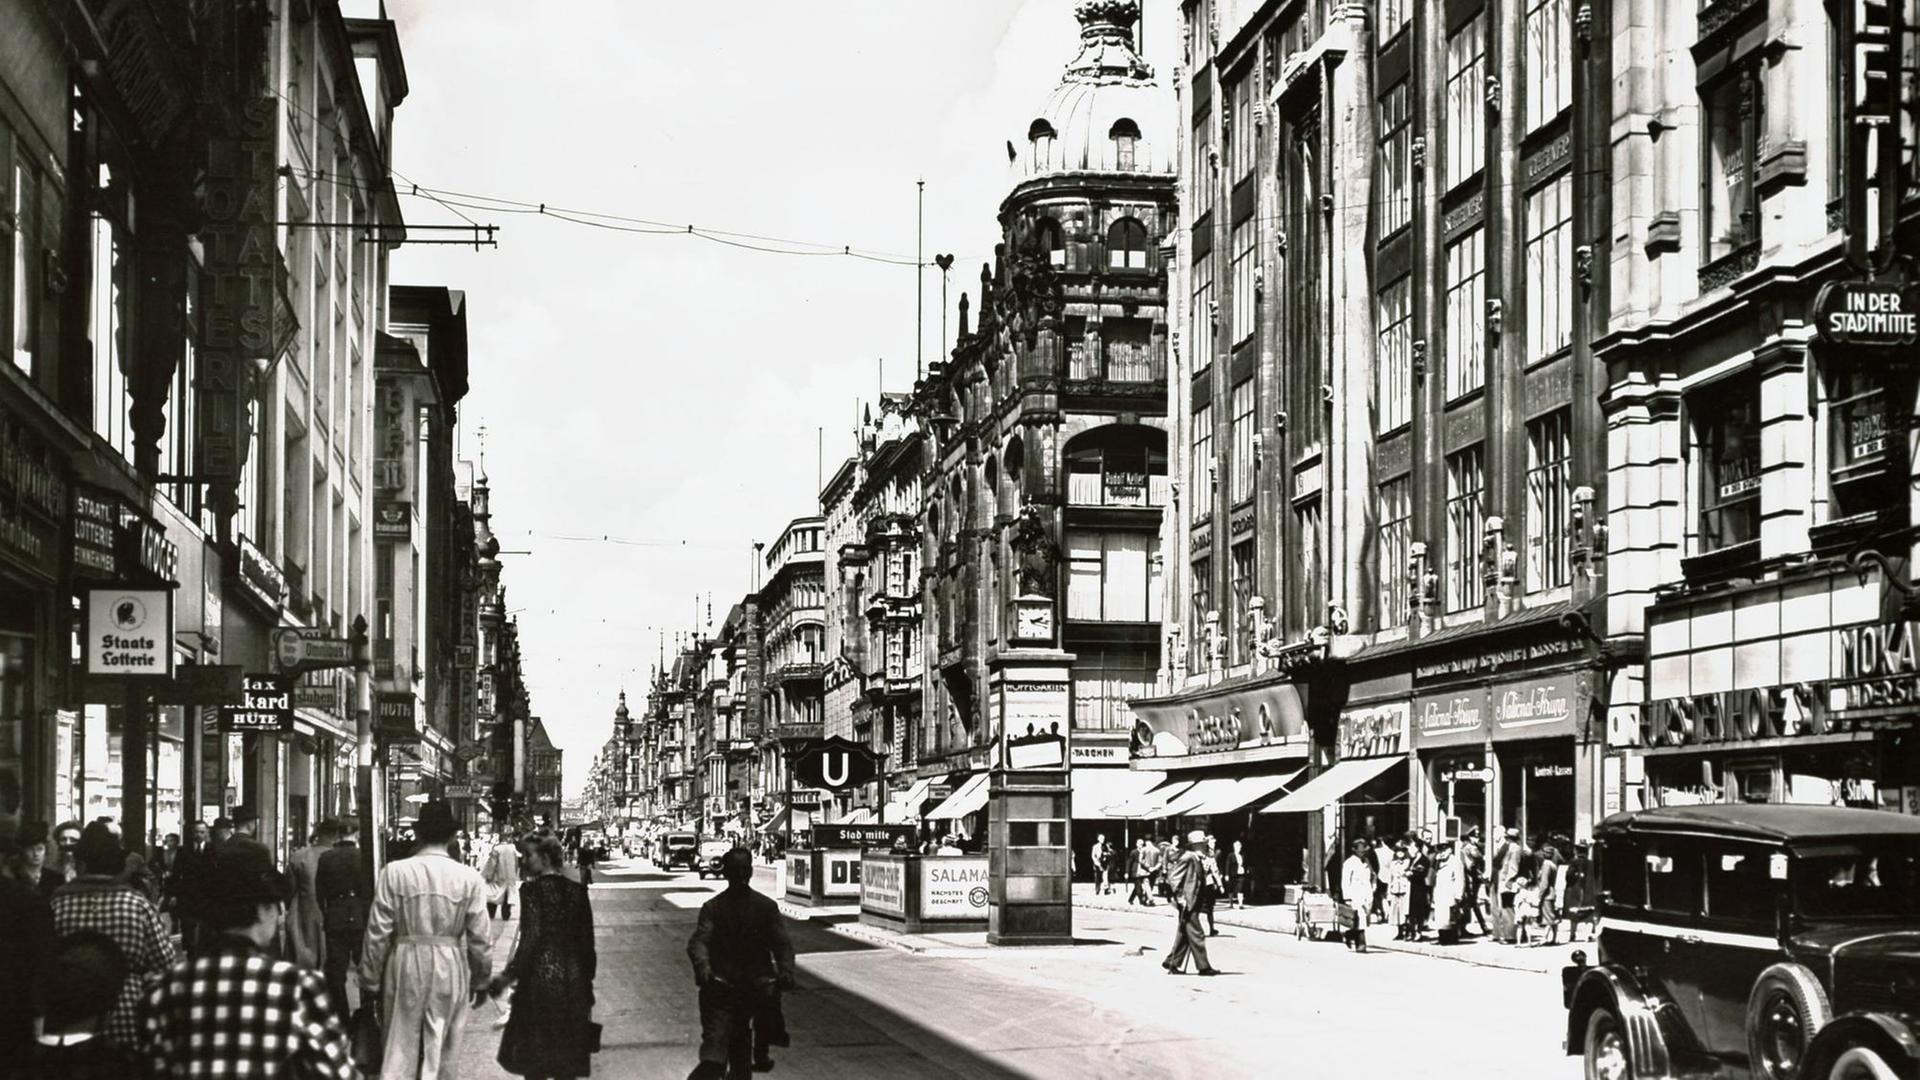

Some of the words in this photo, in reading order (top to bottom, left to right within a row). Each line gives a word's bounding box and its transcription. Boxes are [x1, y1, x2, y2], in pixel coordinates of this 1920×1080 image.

[239, 97, 273, 349] STAATS
[203, 138, 238, 476] LOTTERIE
[1848, 292, 1866, 312] IN
[1868, 292, 1902, 313] DER
[1829, 312, 1917, 334] STADTMITTE
[74, 518, 114, 549] LOTTERIE
[101, 634, 156, 649] Staats
[1840, 620, 1918, 681] MOKA
[102, 651, 156, 666] Lotterie
[223, 692, 290, 710] kard
[233, 711, 278, 725] HÜTE
[823, 753, 851, 787] U
[839, 829, 890, 843] Stadmitte
[930, 868, 990, 883] SALAMA
